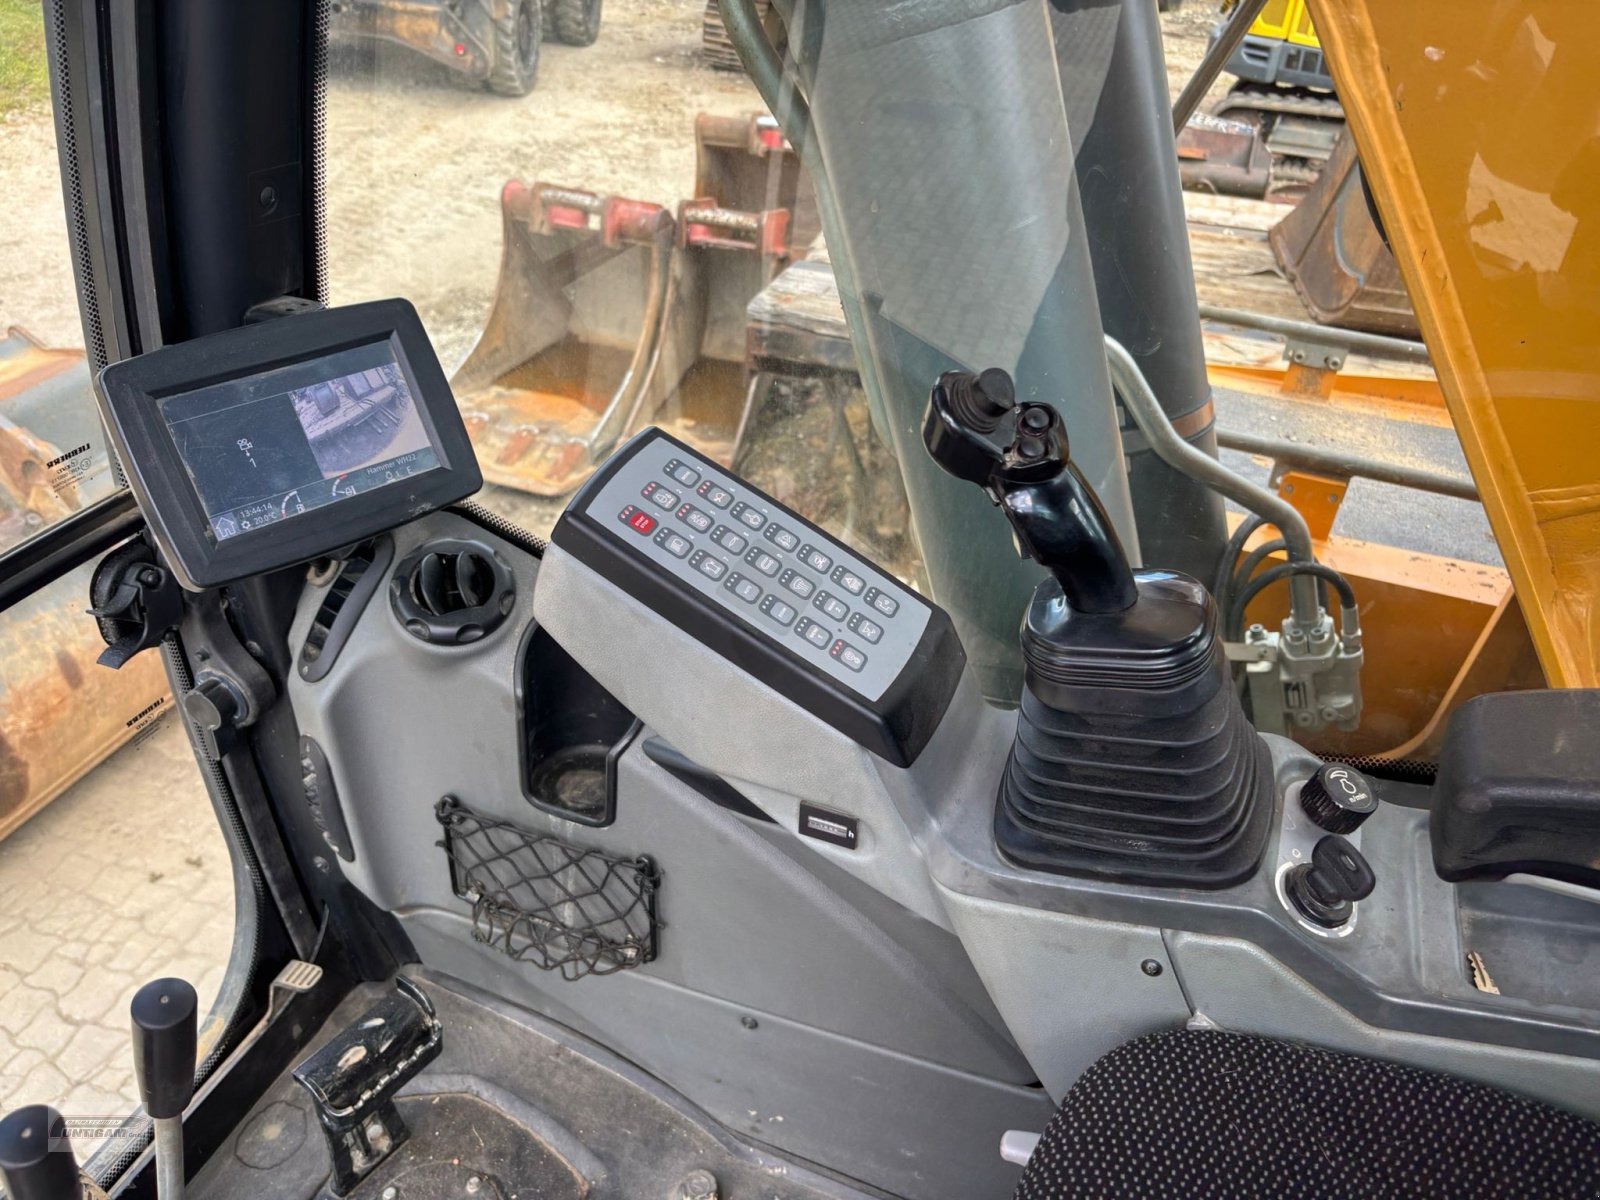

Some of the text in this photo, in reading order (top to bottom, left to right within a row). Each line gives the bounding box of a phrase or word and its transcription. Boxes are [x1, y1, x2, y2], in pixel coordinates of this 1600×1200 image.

[249, 458, 257, 468] 1
[367, 462, 396, 475] Hammer
[240, 502, 273, 518] 13:44:14
[847, 830, 855, 839] h
